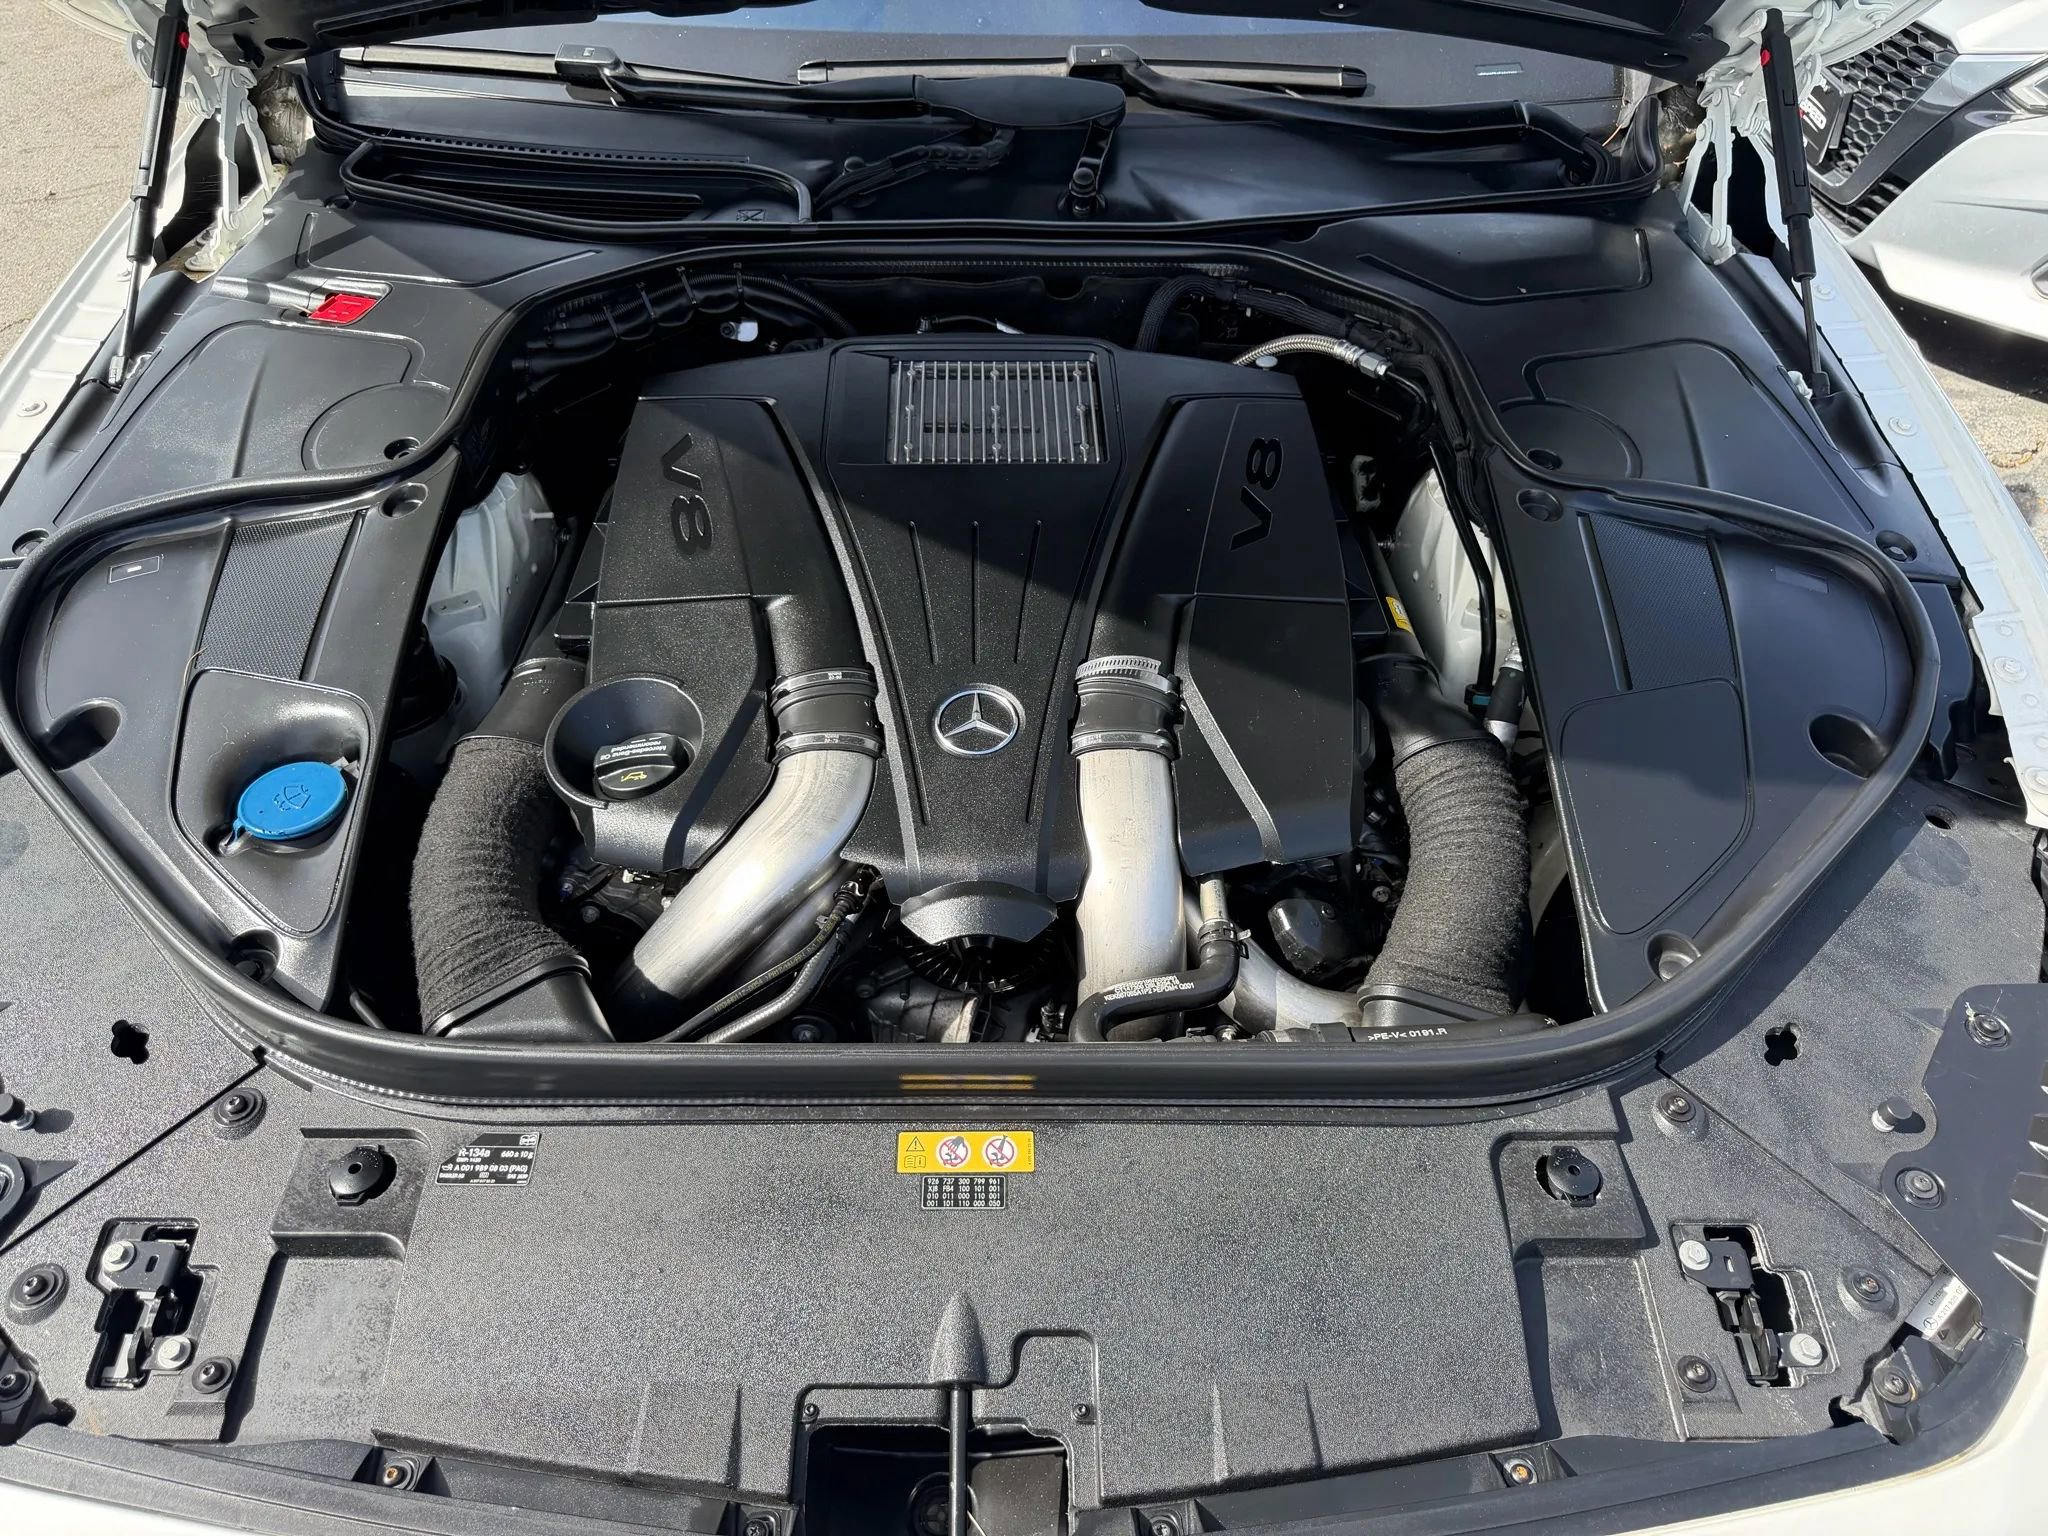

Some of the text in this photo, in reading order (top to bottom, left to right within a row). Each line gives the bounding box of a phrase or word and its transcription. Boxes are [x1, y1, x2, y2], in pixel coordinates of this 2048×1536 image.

[660, 432, 713, 555] V8
[1229, 437, 1283, 552] V8
[611, 740, 662, 753] recommended
[612, 745, 667, 758] Mercedes-Benz
[458, 1147, 491, 1158] R-134a
[500, 1150, 514, 1158] 660
[520, 1150, 528, 1158] 10
[474, 1164, 489, 1172] 989
[508, 1164, 528, 1173] (PAG)
